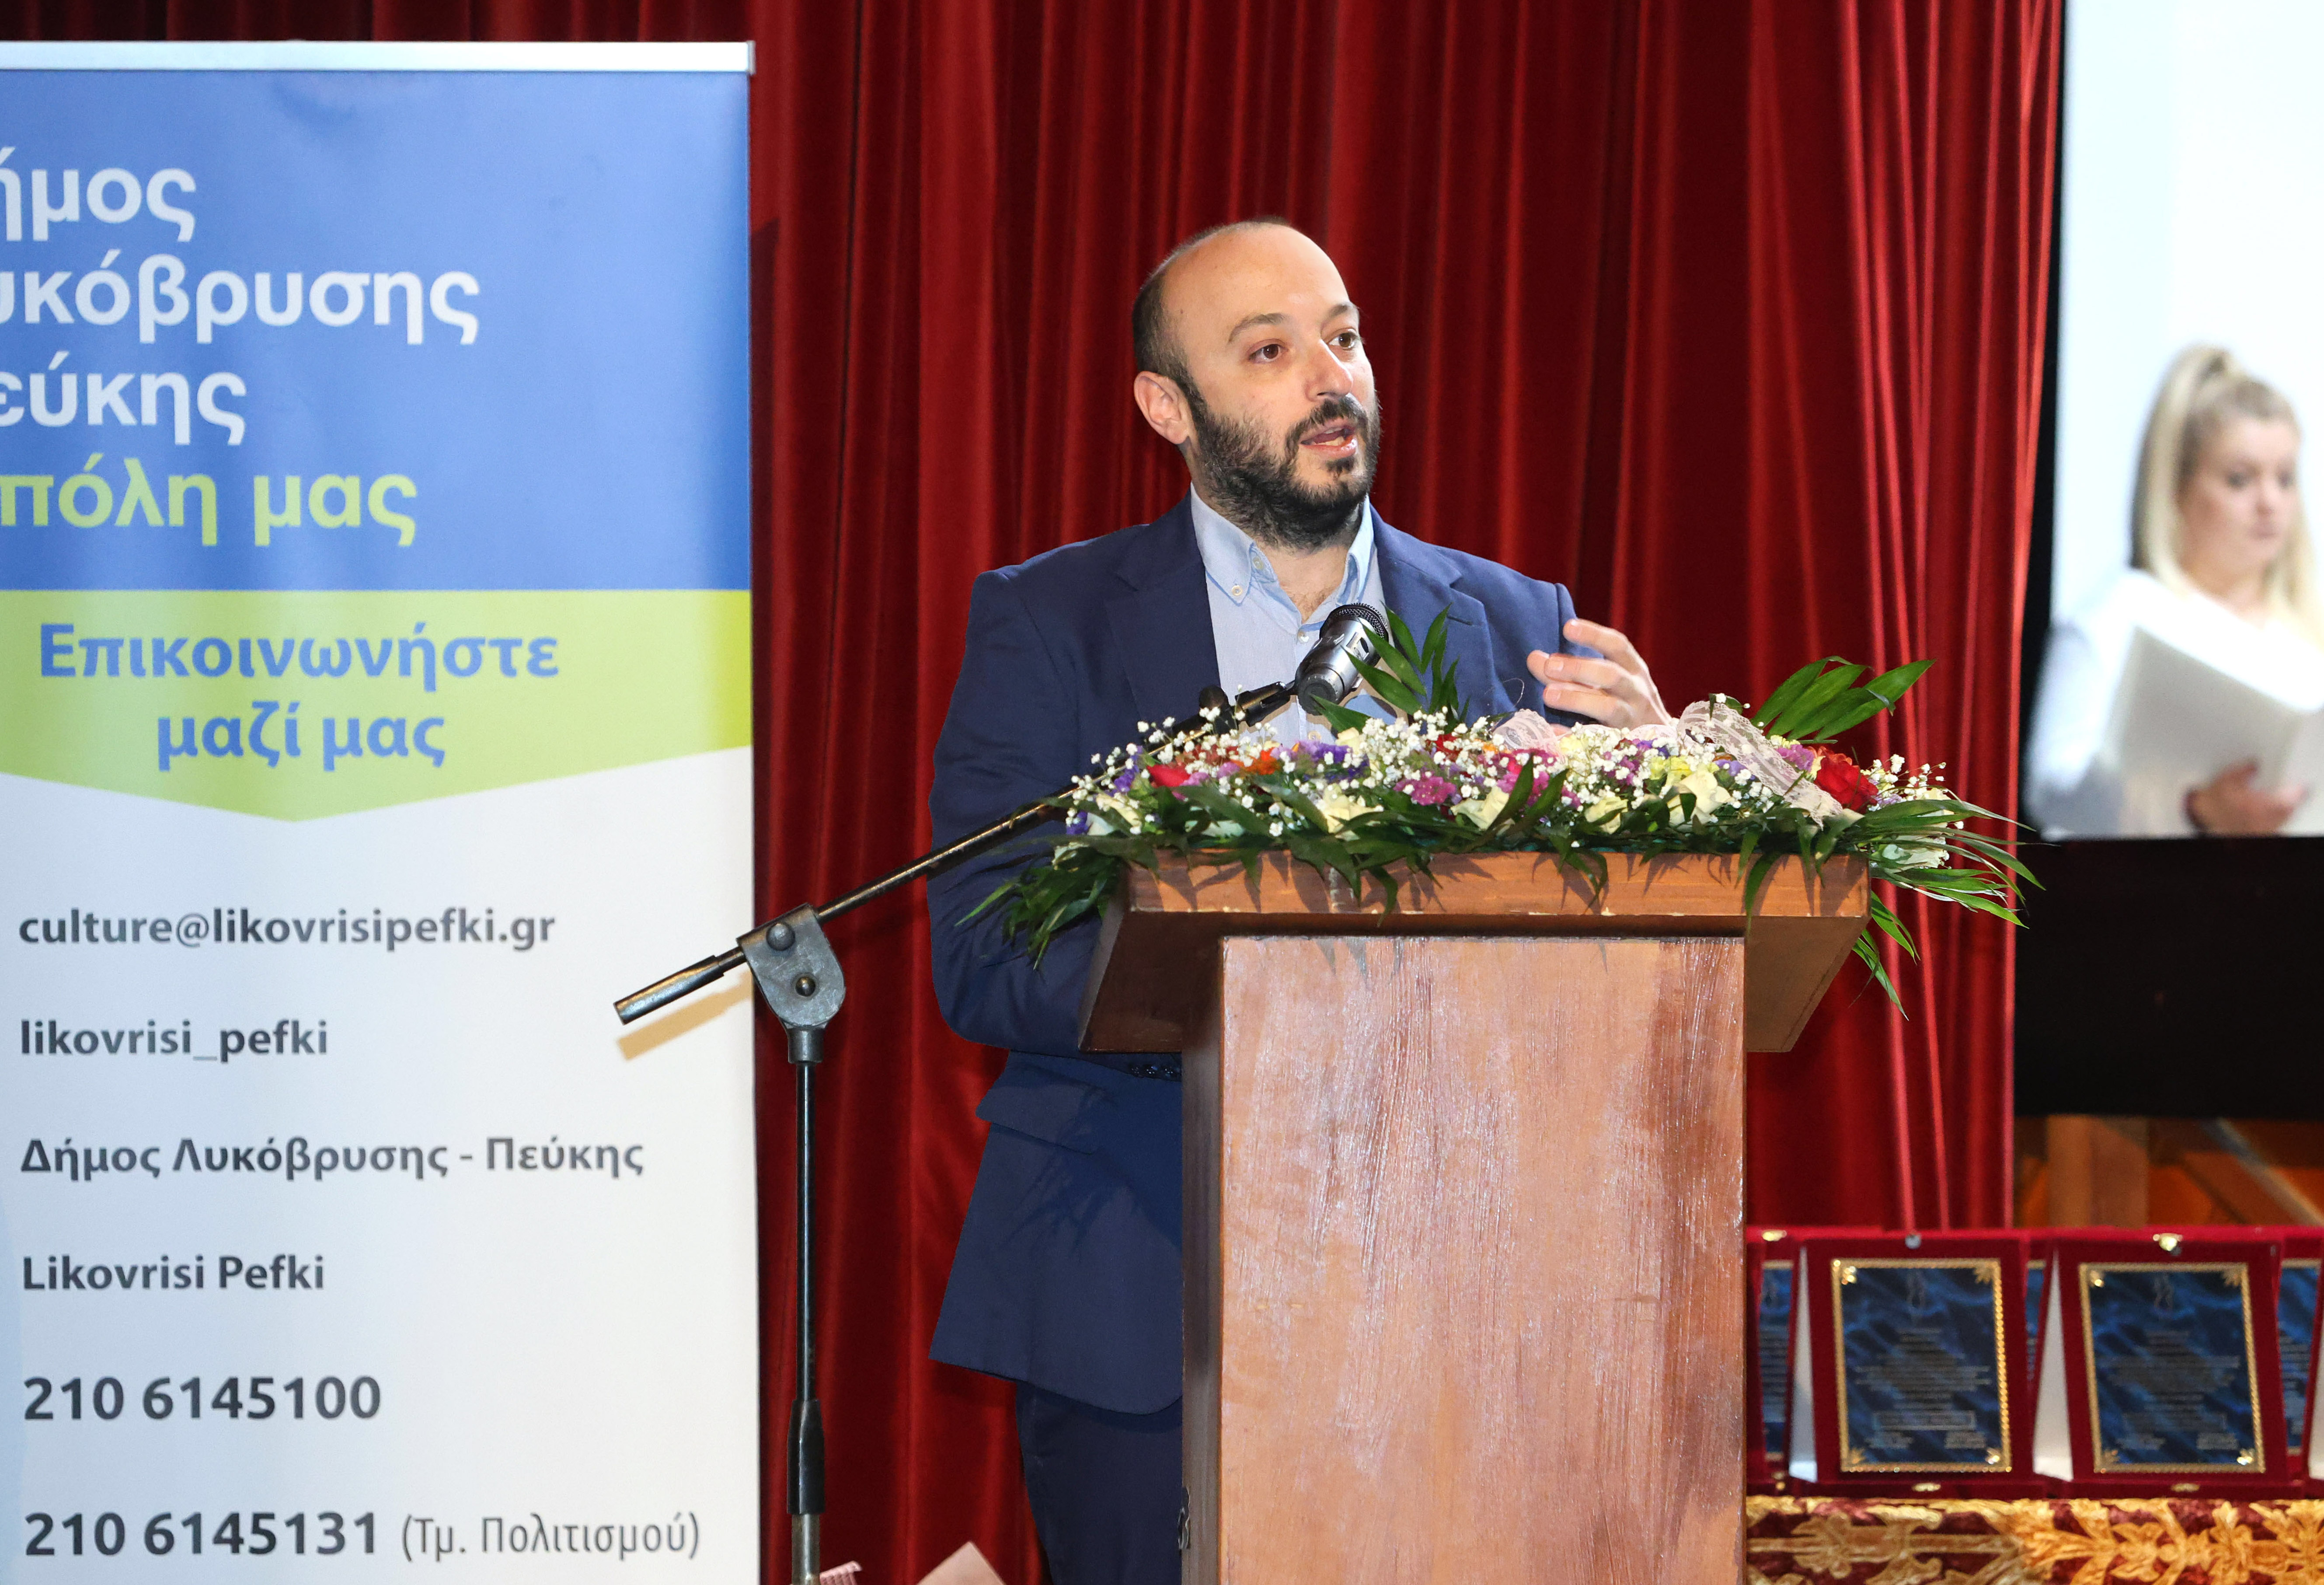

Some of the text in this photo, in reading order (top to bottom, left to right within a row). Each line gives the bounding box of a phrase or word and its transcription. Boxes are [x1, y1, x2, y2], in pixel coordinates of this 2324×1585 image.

[0, 453, 417, 547] πόλη μας
[41, 622, 559, 692] Επικοινωνήστε
[158, 701, 446, 772] μαζί μας
[19, 908, 555, 952] culture@likovrisipefki.gr
[21, 1019, 327, 1063] likovrisi_pefki
[21, 1138, 160, 1181] Δήμος
[172, 1137, 448, 1181] Λυκόβρυσης
[487, 1136, 643, 1179] Πεύκης
[23, 1254, 323, 1290] Likovrisi Pefki
[24, 1376, 380, 1420] 210 6145100
[25, 1512, 699, 1562] 210 6145131 (Τμ. Πολιτισμού)
